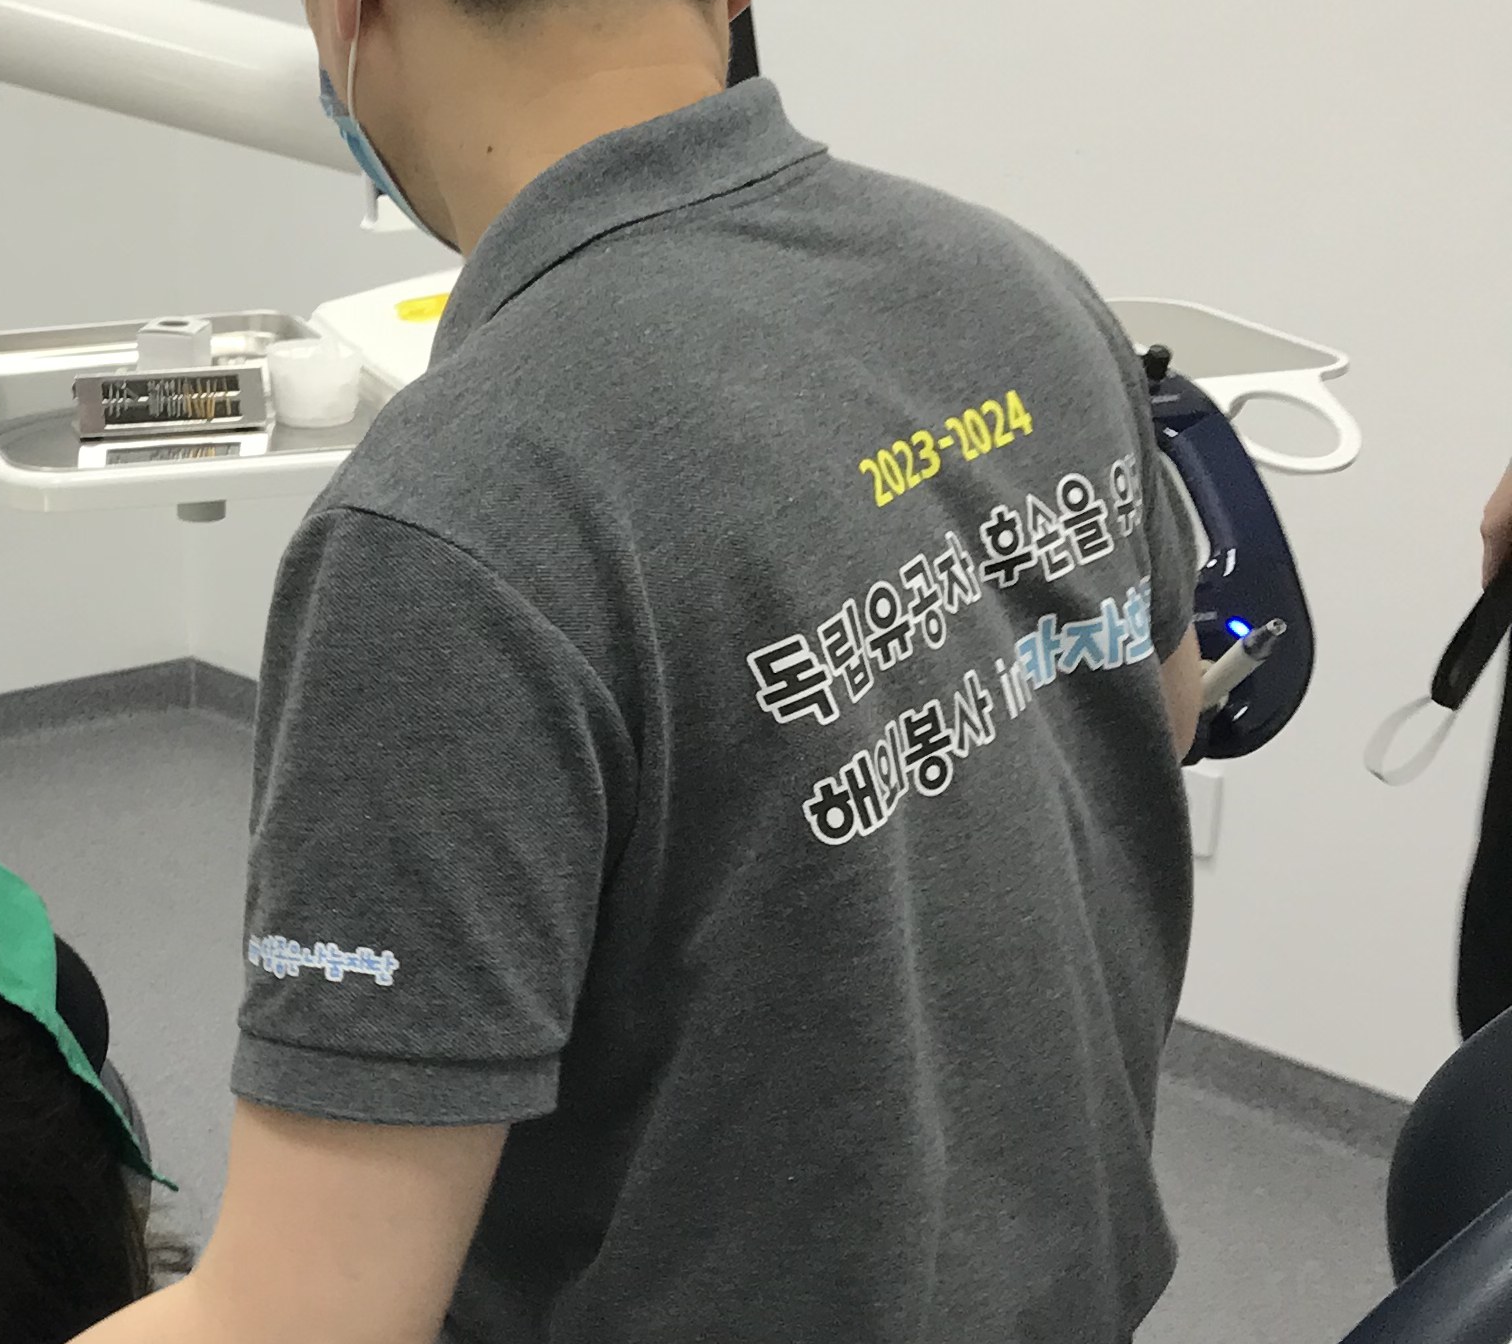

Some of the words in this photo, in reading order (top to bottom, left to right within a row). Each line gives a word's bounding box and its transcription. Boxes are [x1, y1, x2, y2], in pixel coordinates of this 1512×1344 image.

[858, 389, 1034, 508] 2023-2024
[746, 531, 981, 725] 독립유공자
[981, 473, 1114, 588] 후손을
[802, 669, 996, 845] 해외봉사
